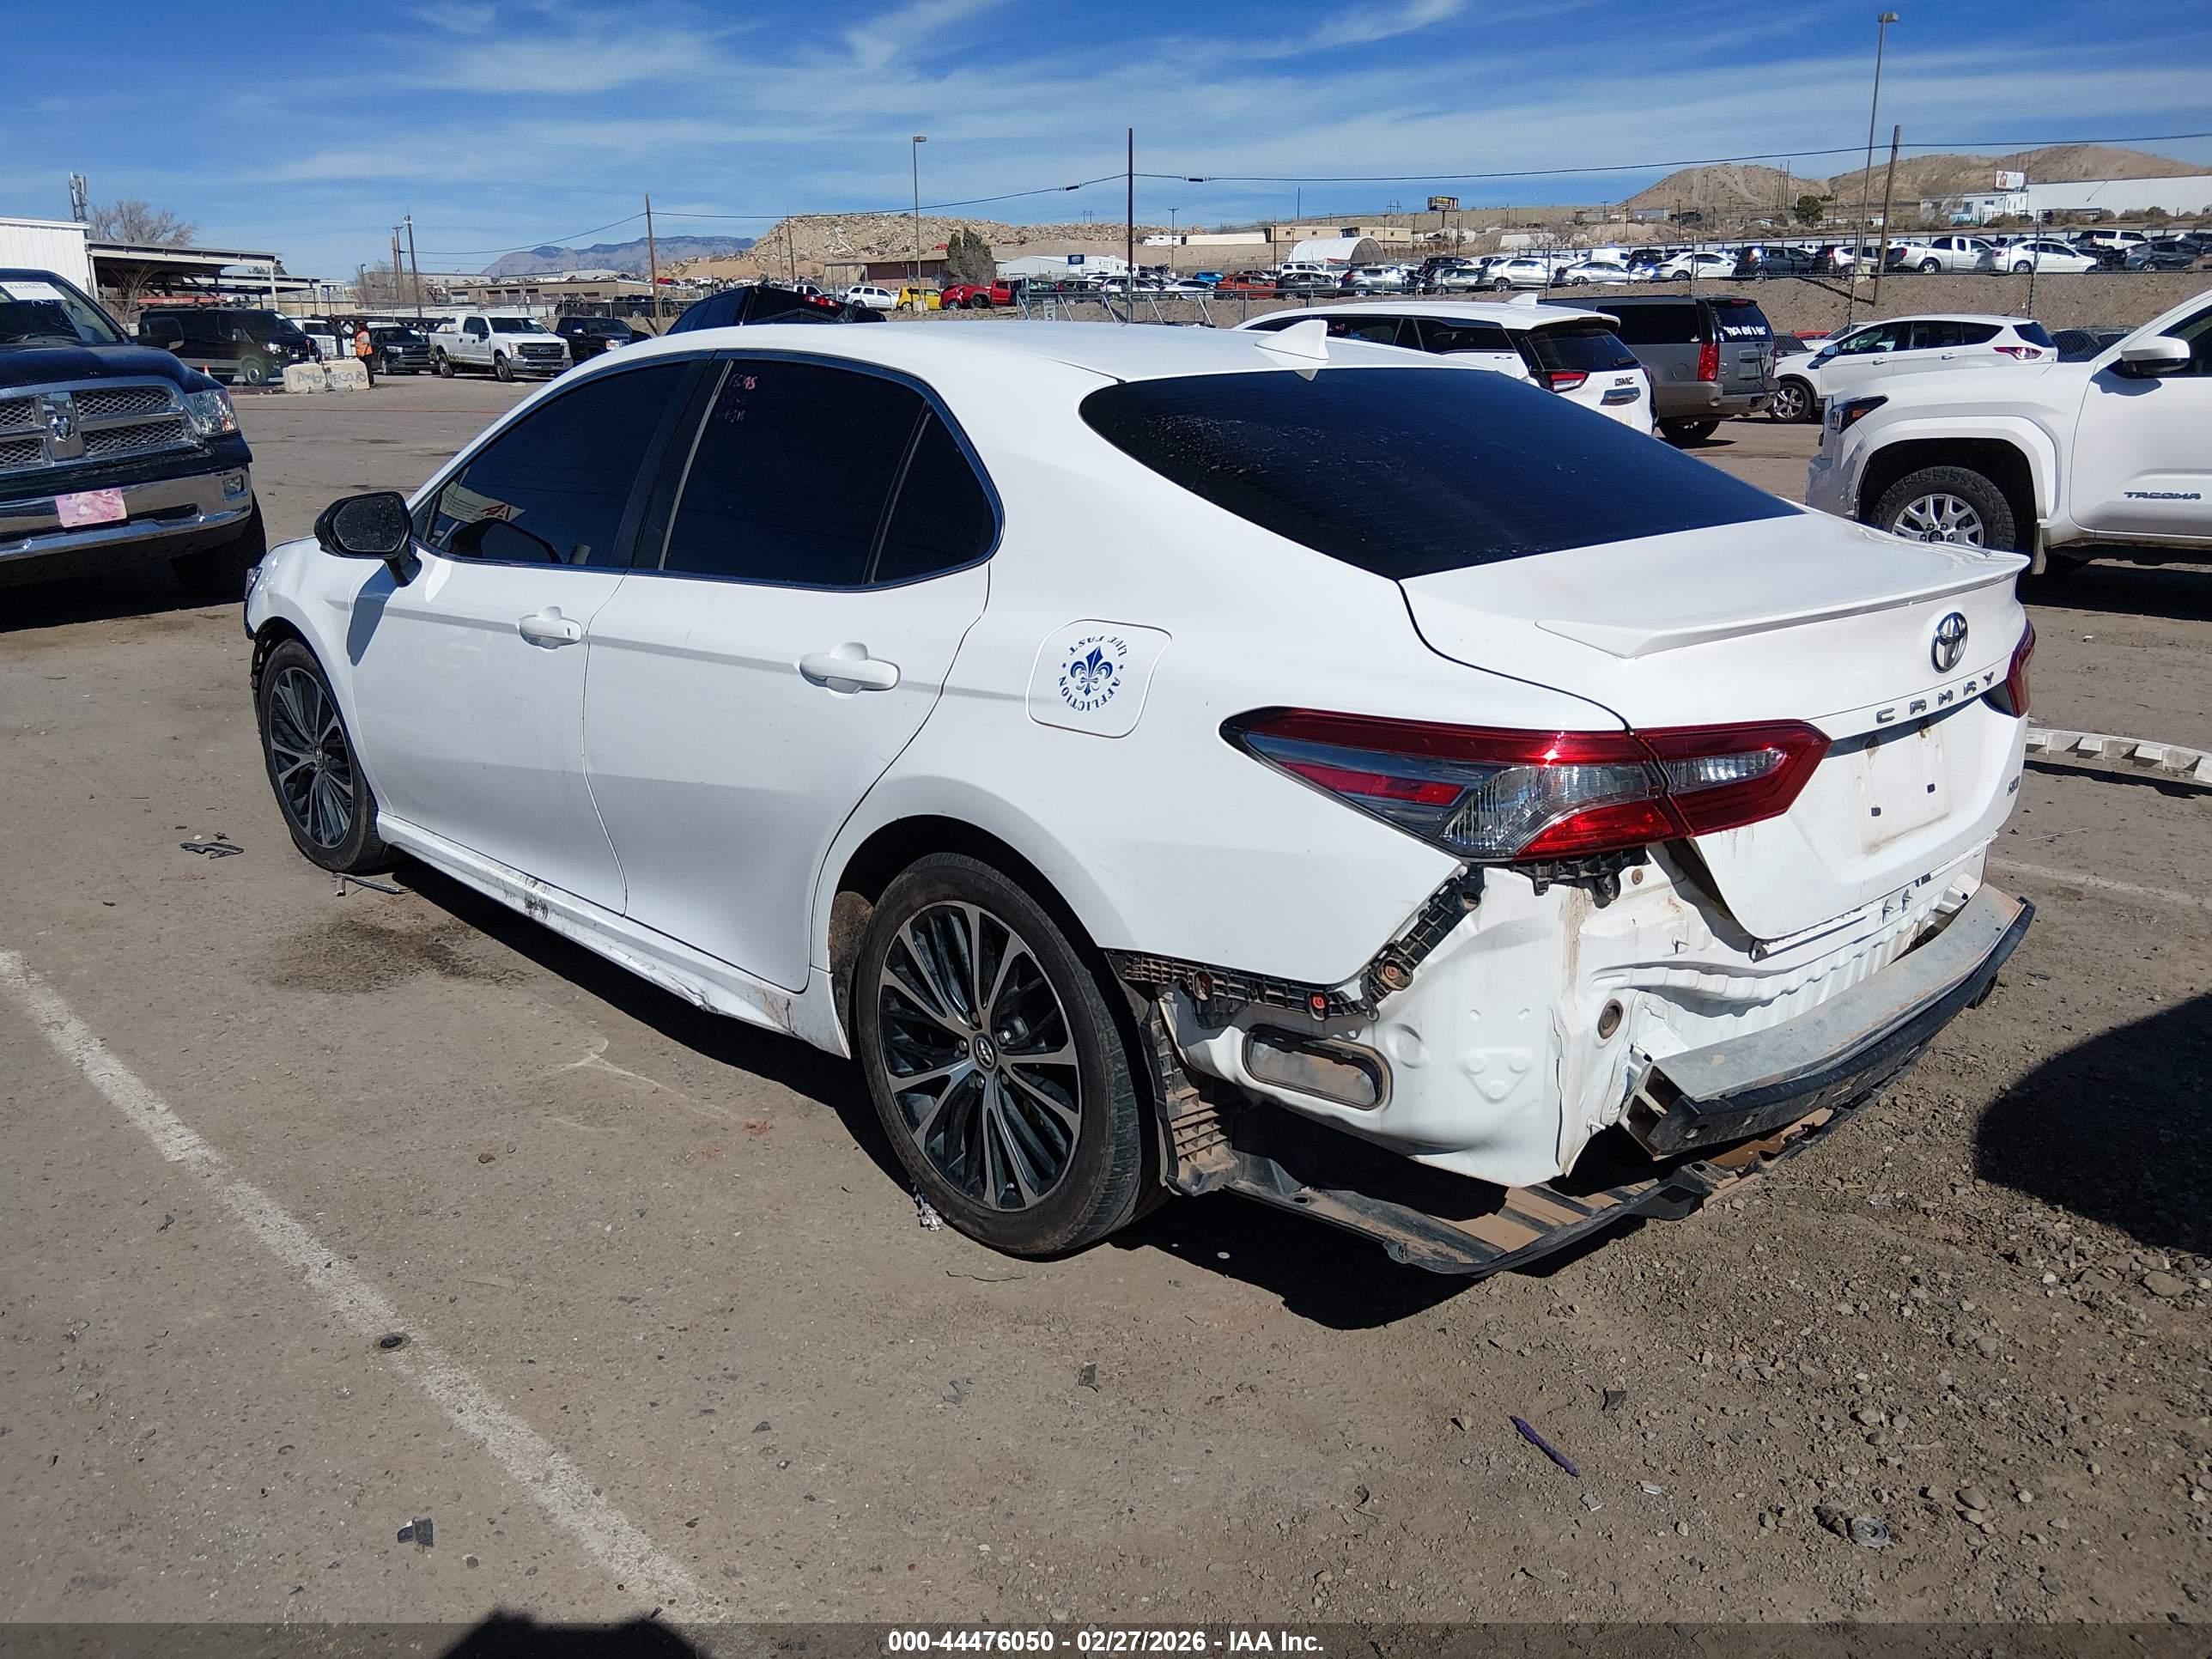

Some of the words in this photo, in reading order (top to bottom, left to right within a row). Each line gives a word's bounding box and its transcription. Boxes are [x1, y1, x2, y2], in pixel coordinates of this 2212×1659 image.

[1048, 313, 1053, 321] 5
[1614, 377, 1634, 386] GMC
[2124, 491, 2202, 500] TACOMA
[1068, 635, 1105, 655] FAST
[1108, 636, 1127, 657] LIVE
[1058, 676, 1121, 711] AFFLICTION
[1875, 672, 1995, 724] CAMRY
